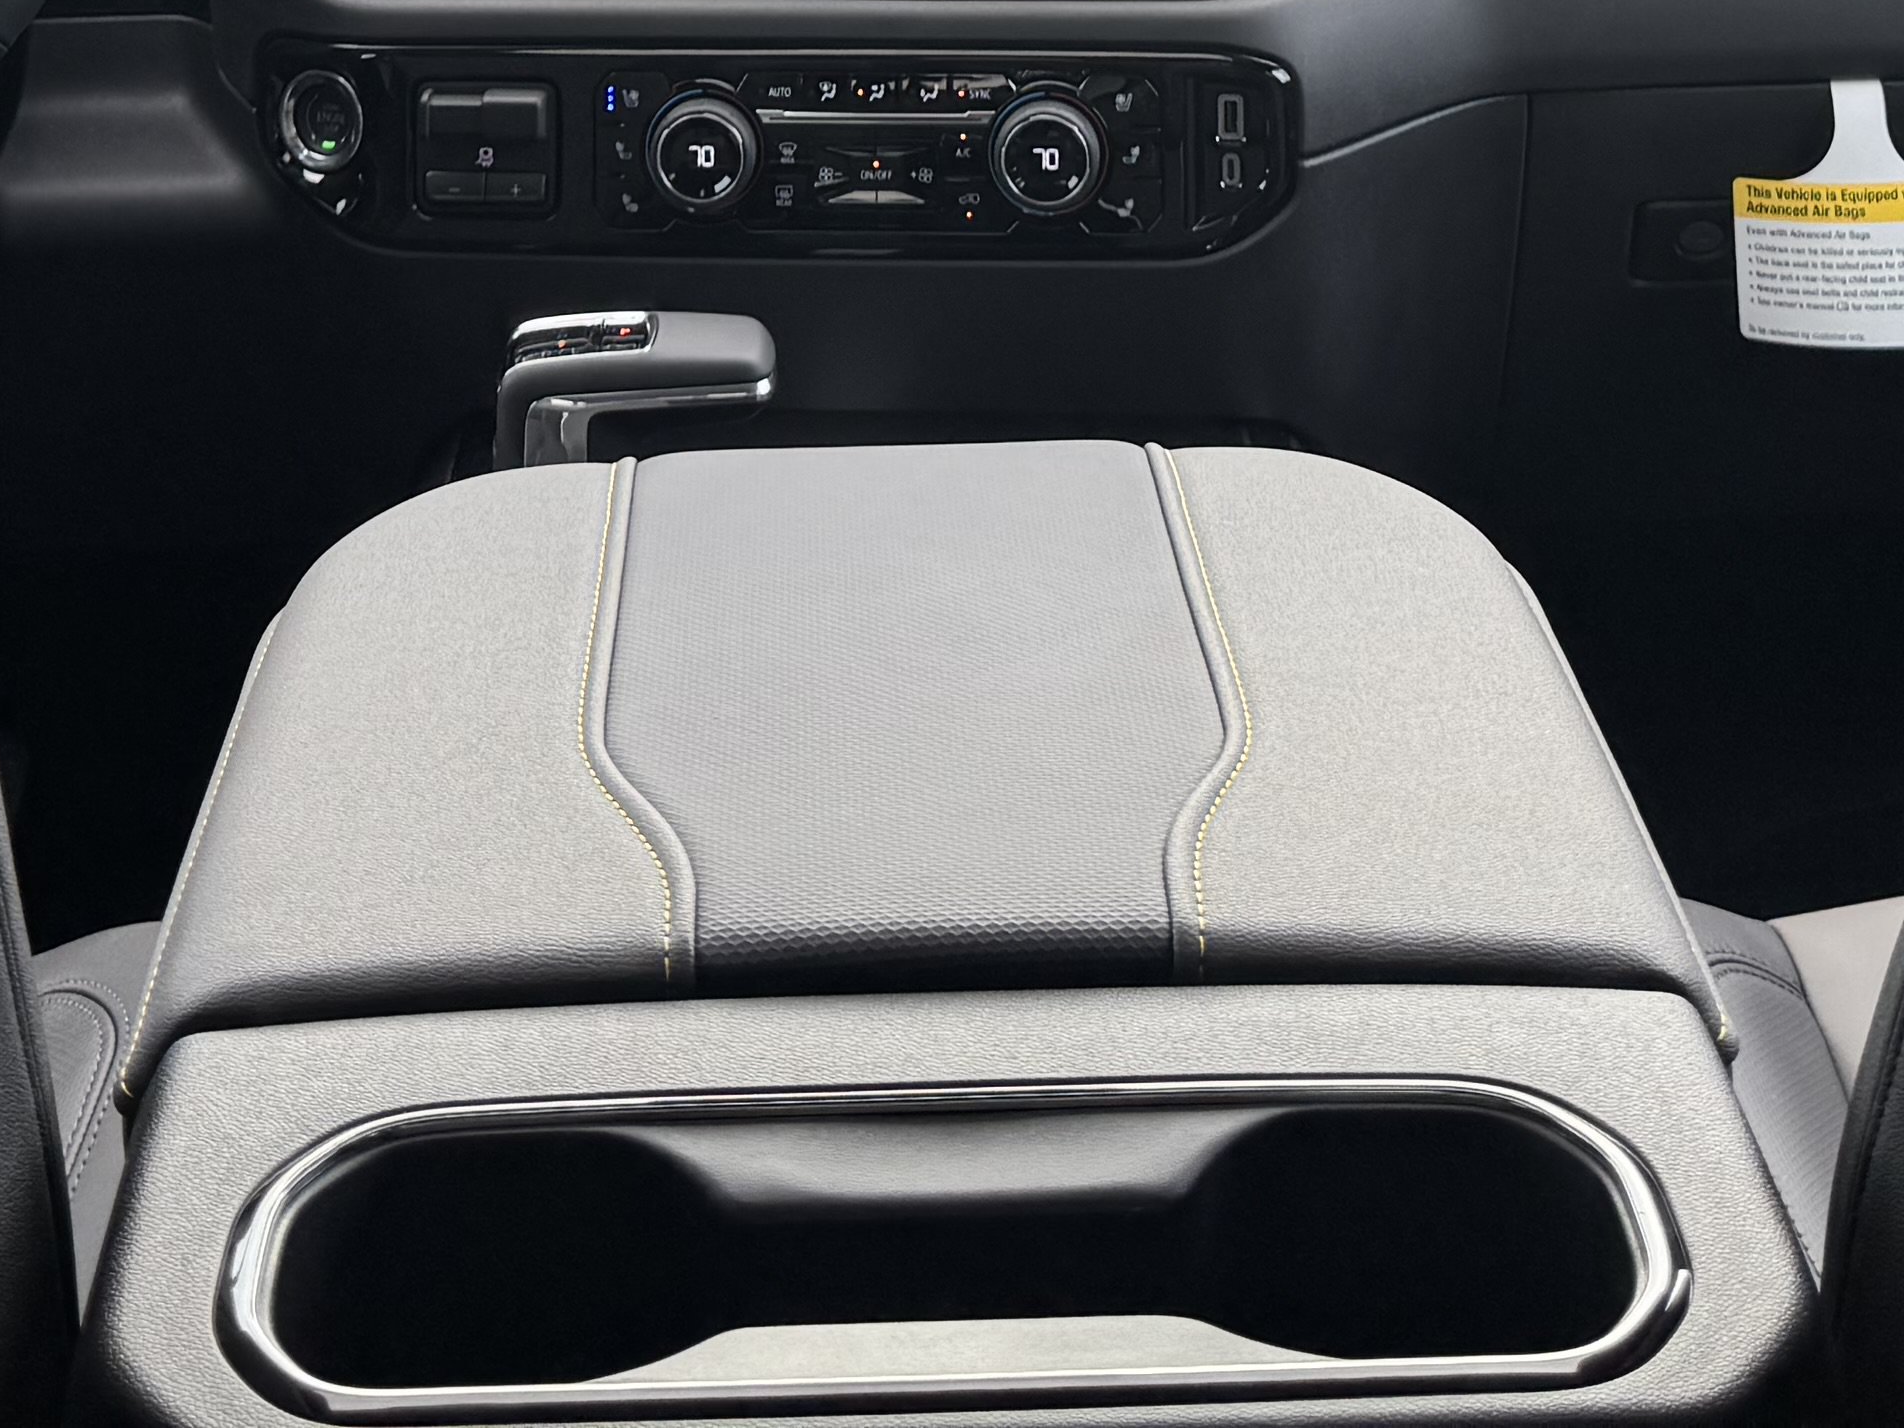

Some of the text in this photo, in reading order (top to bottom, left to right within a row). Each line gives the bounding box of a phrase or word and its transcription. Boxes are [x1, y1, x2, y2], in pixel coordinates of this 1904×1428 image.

[768, 87, 792, 98] AUTO
[969, 89, 992, 100] SYNC
[688, 145, 714, 168] 70
[956, 148, 972, 158] A/C
[1033, 148, 1059, 170] 70
[860, 170, 892, 180] ON/OFF
[1747, 186, 1771, 198] This
[1776, 187, 1822, 202] Vehicle
[1826, 188, 1836, 202] is
[1841, 188, 1898, 204] Equipped
[1746, 202, 1866, 220] Advanced Air Bags
